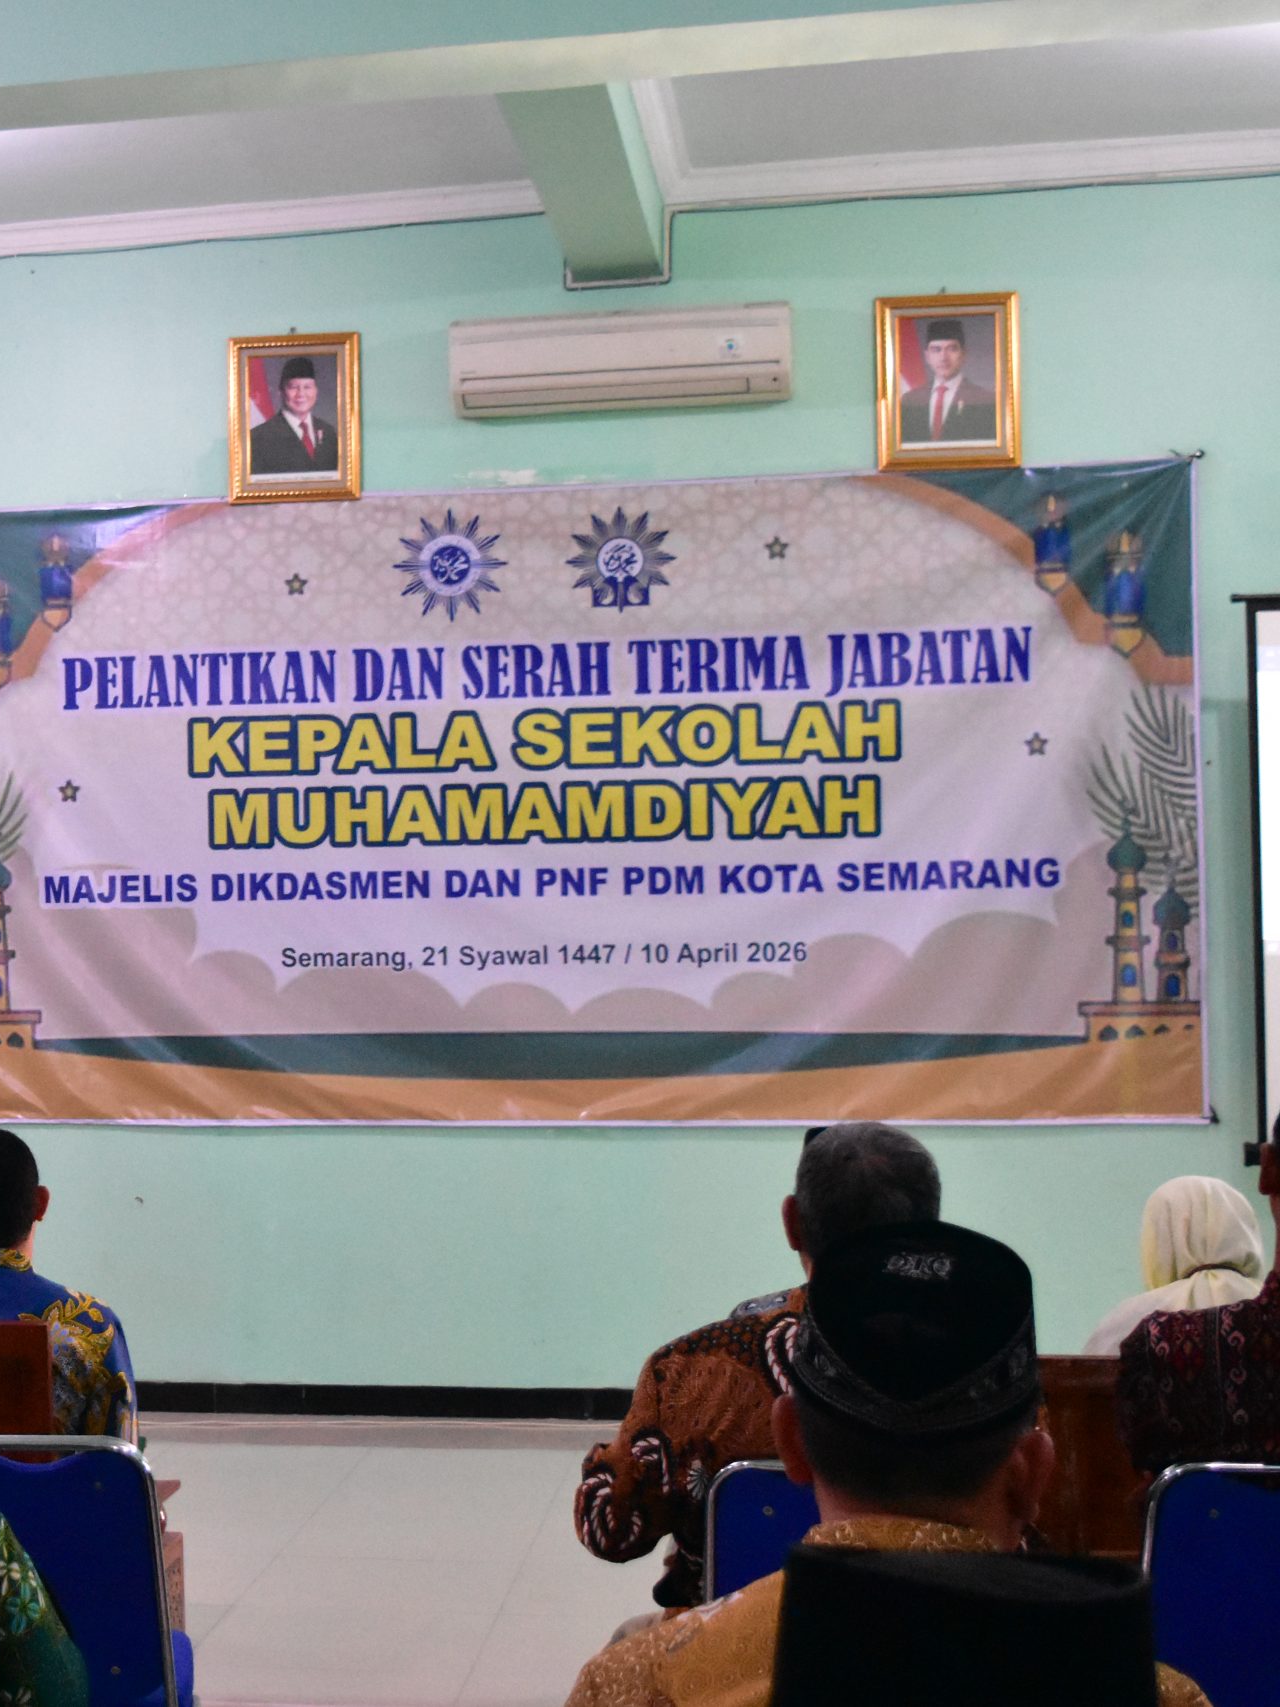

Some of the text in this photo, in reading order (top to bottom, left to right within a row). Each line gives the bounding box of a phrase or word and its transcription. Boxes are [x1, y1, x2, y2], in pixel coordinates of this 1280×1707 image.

[62, 626, 1033, 711] PELANTIKAN DAN SERAH TERIMA JABATAN
[189, 699, 901, 778] KEPALA SEKOLAH
[209, 776, 880, 849] MUHAMAMDIYAH
[45, 857, 1060, 904] MAJELIS DIKDASMEN DAN PNF PDM KOTA SEMARANG
[281, 941, 807, 972] Semarang, 21 Syawal 1447 / 10 April 2026
